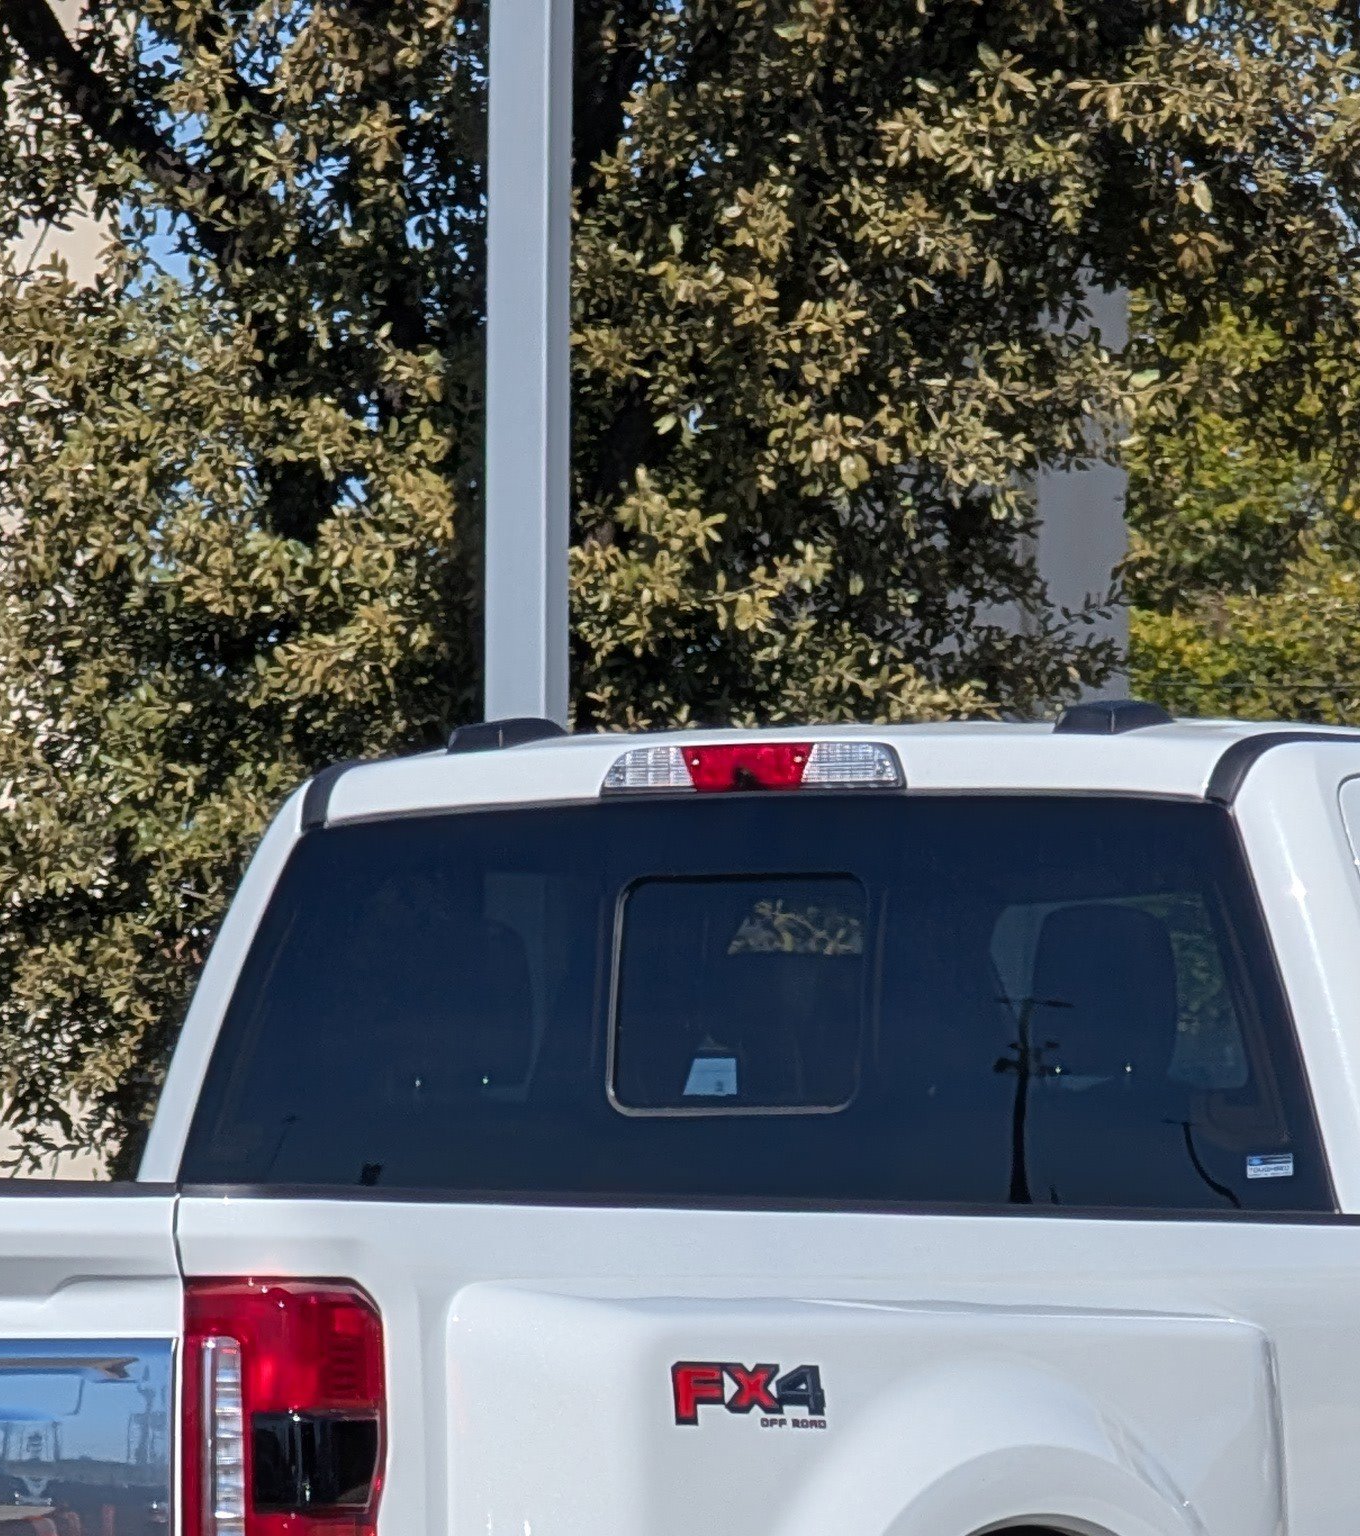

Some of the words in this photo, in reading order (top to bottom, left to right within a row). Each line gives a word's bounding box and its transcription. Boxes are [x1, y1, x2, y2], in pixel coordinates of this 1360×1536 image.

[671, 1361, 826, 1426] FX4
[760, 1417, 787, 1429] OFF
[792, 1418, 827, 1430] ROAD
